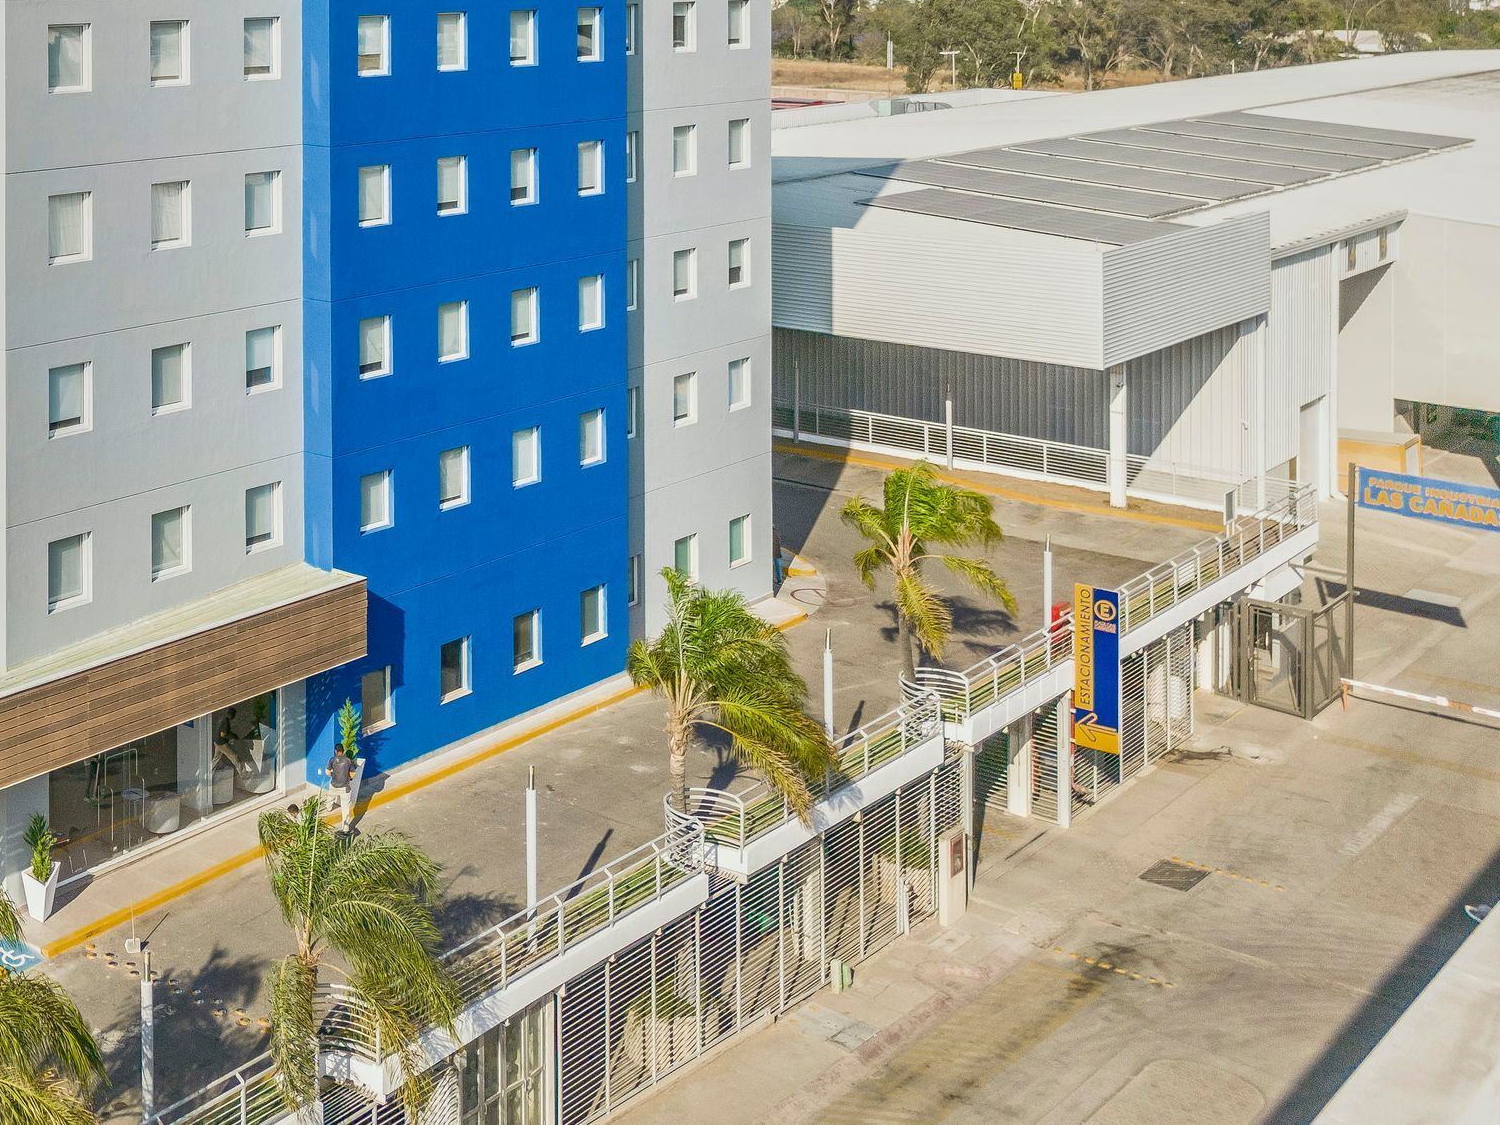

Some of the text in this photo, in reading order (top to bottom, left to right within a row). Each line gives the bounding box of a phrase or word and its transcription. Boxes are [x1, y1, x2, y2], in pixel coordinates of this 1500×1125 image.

[1368, 477, 1421, 495] PARQUE
[1364, 487, 1500, 527] LAS CAÑADA
[1079, 588, 1091, 706] ESTACIONAMIENTO
